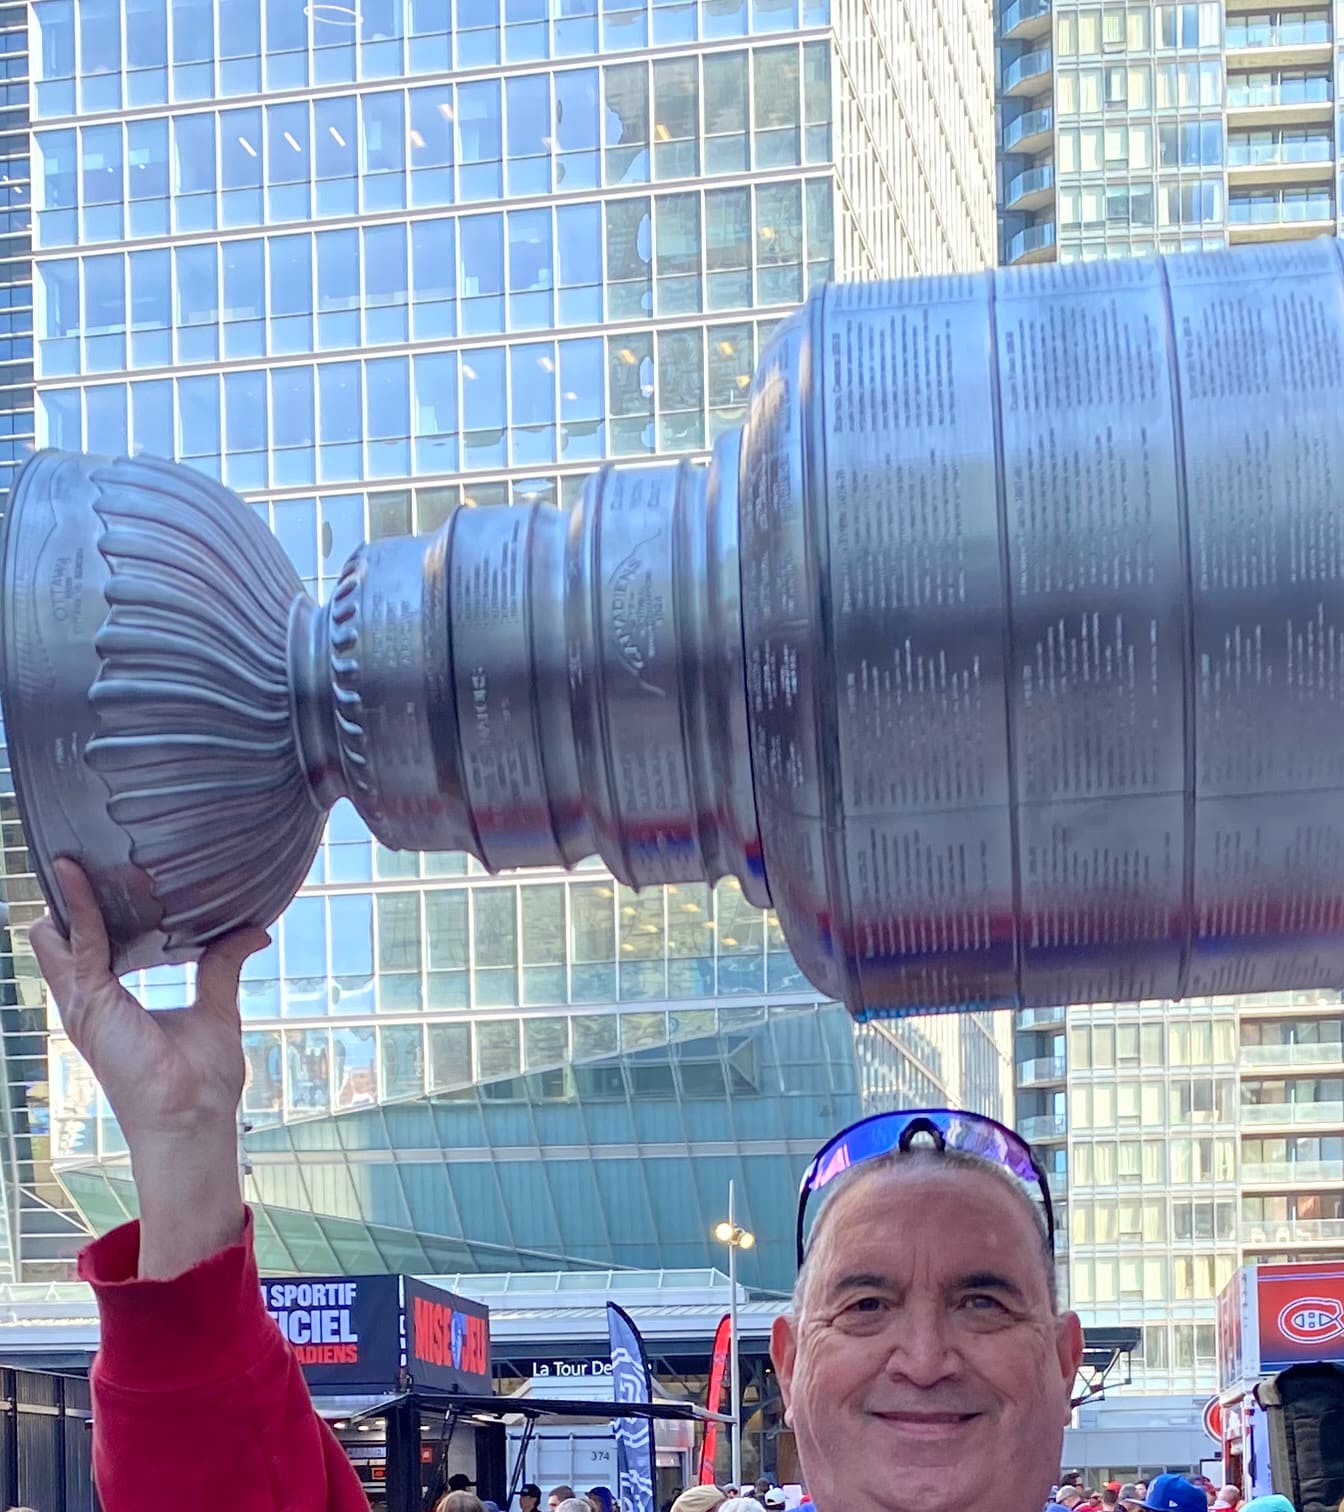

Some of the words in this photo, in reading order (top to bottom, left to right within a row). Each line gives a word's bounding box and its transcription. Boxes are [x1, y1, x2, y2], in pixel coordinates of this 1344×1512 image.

[270, 1283, 357, 1307] SPORTIF
[532, 1361, 550, 1377] La
[555, 1361, 589, 1377] Tour
[591, 1451, 610, 1461] 374
